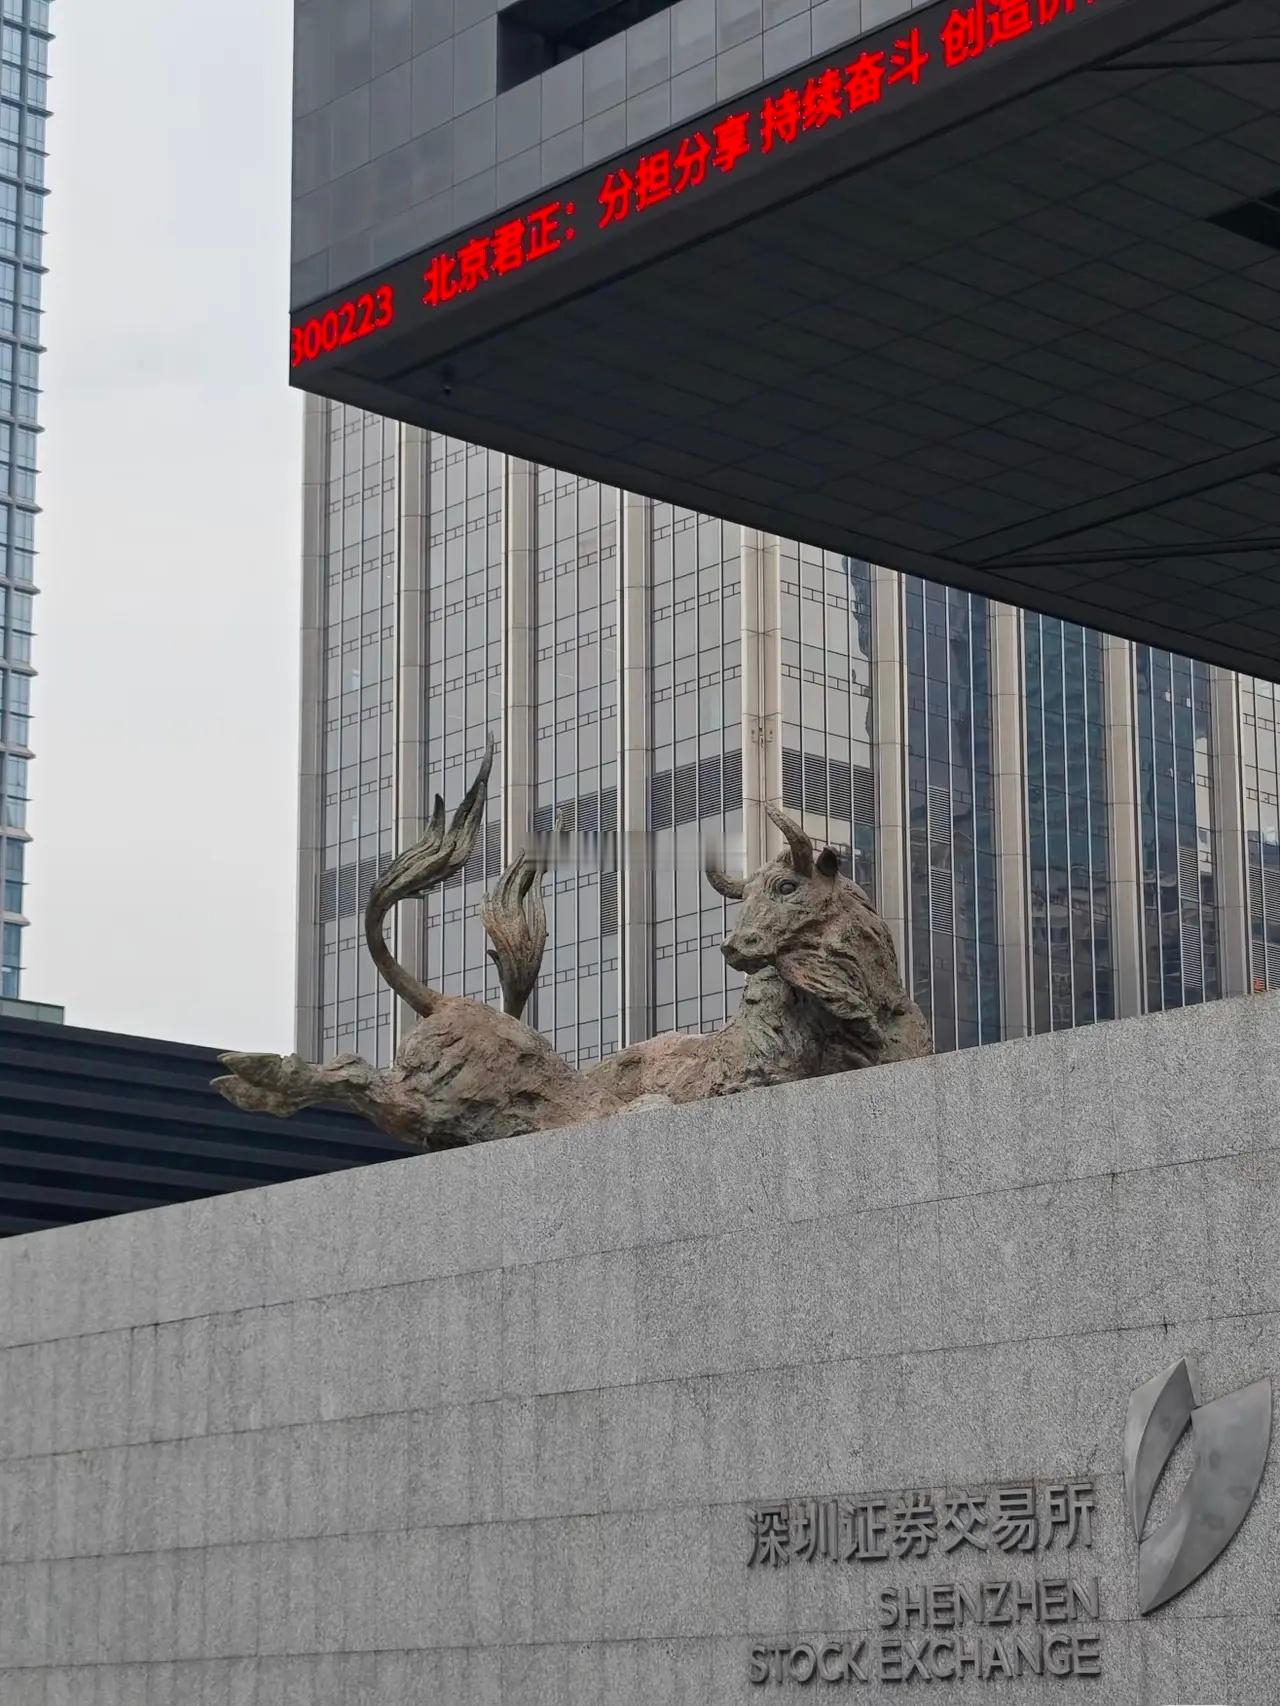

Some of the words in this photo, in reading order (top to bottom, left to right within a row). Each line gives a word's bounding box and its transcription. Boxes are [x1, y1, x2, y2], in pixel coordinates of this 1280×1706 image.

[598, 111, 752, 229] 分担分享
[760, 27, 931, 154] 持续奋斗
[747, 1482, 1096, 1566] 深圳证券交易所
[878, 1577, 1100, 1628] SHENZHEN
[748, 1640, 869, 1684] STOCK
[879, 1632, 1101, 1682] EXCHANGE
